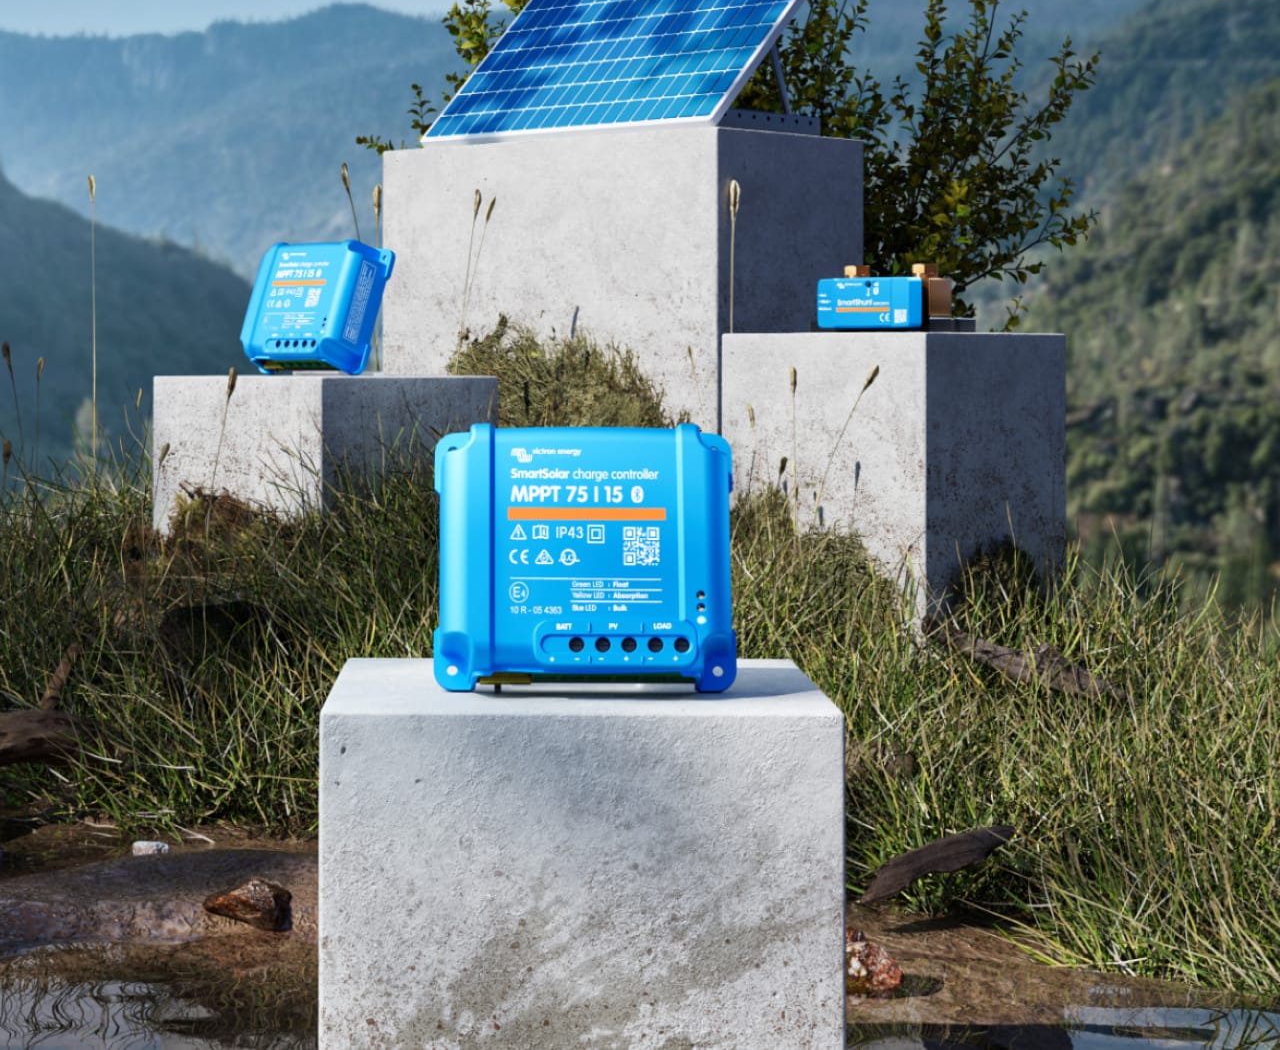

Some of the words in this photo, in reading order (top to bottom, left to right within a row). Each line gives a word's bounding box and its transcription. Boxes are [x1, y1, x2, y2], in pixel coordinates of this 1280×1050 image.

[557, 448, 582, 457] energy
[510, 468, 570, 480] SmartSolar
[572, 467, 608, 482] charge
[611, 468, 659, 480] controller
[510, 485, 561, 503] MPPT
[565, 485, 588, 503] 75
[604, 485, 623, 503] 15
[555, 526, 584, 539] IP43
[509, 549, 529, 565] CE
[571, 580, 591, 588] Green
[592, 580, 604, 588] LED
[593, 591, 605, 599] LED
[585, 604, 597, 612] LED
[556, 622, 573, 630] BATT
[608, 622, 619, 630] PV
[653, 622, 672, 630] LOAD
